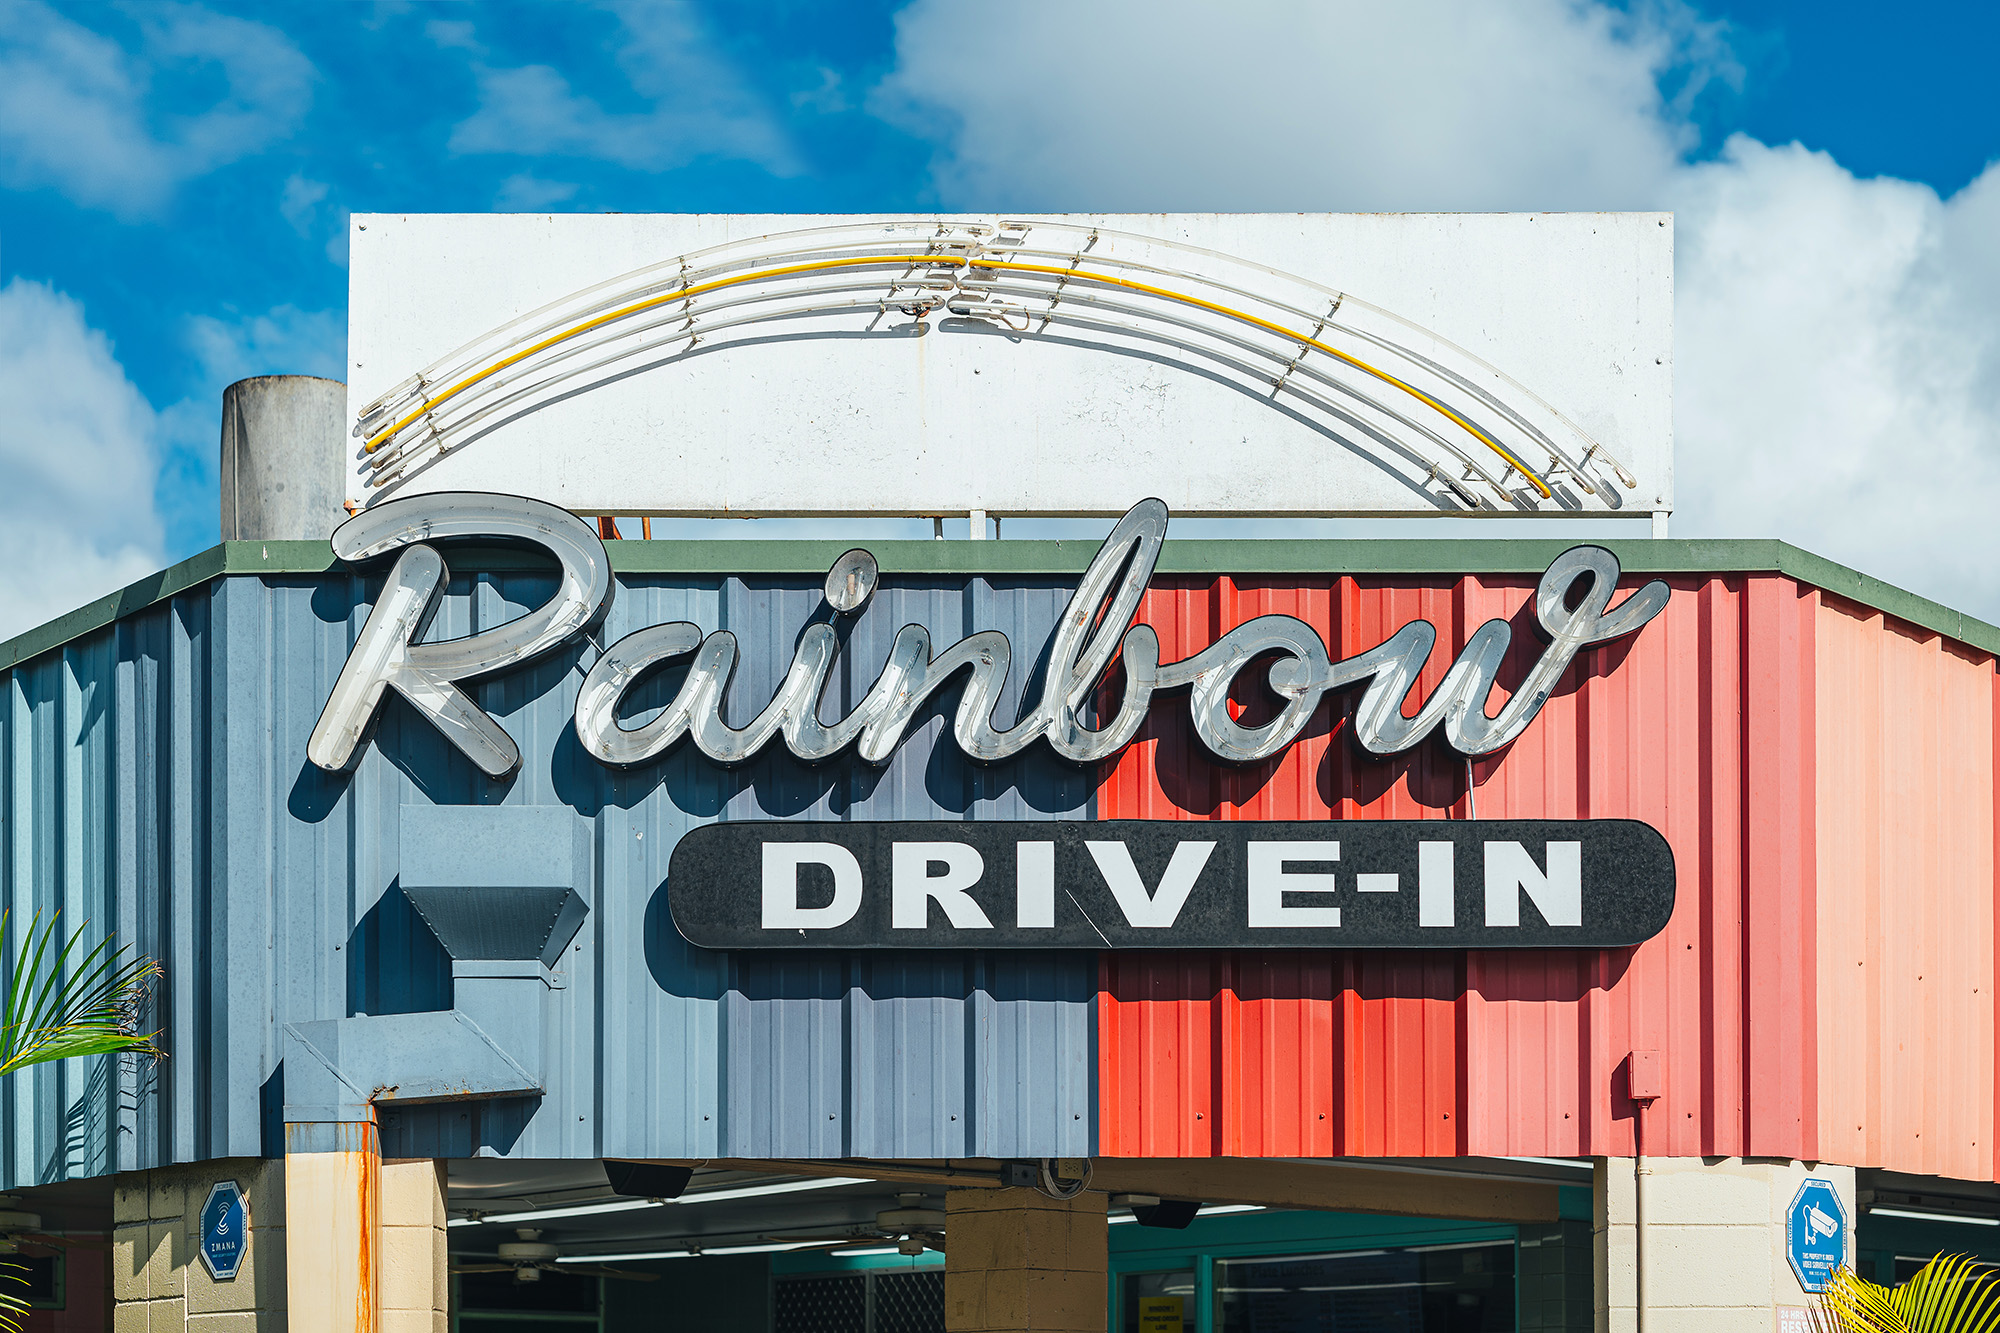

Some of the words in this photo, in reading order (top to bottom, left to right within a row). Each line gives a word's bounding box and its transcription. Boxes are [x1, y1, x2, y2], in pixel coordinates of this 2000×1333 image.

[307, 492, 1671, 776] Rainbow
[760, 840, 1582, 930] DRIVE-IN
[211, 1241, 236, 1252] ZMANA
[1251, 1265, 1277, 1278] Plate
[1280, 1263, 1324, 1277] Lunches
[1781, 1310, 1789, 1319] 24
